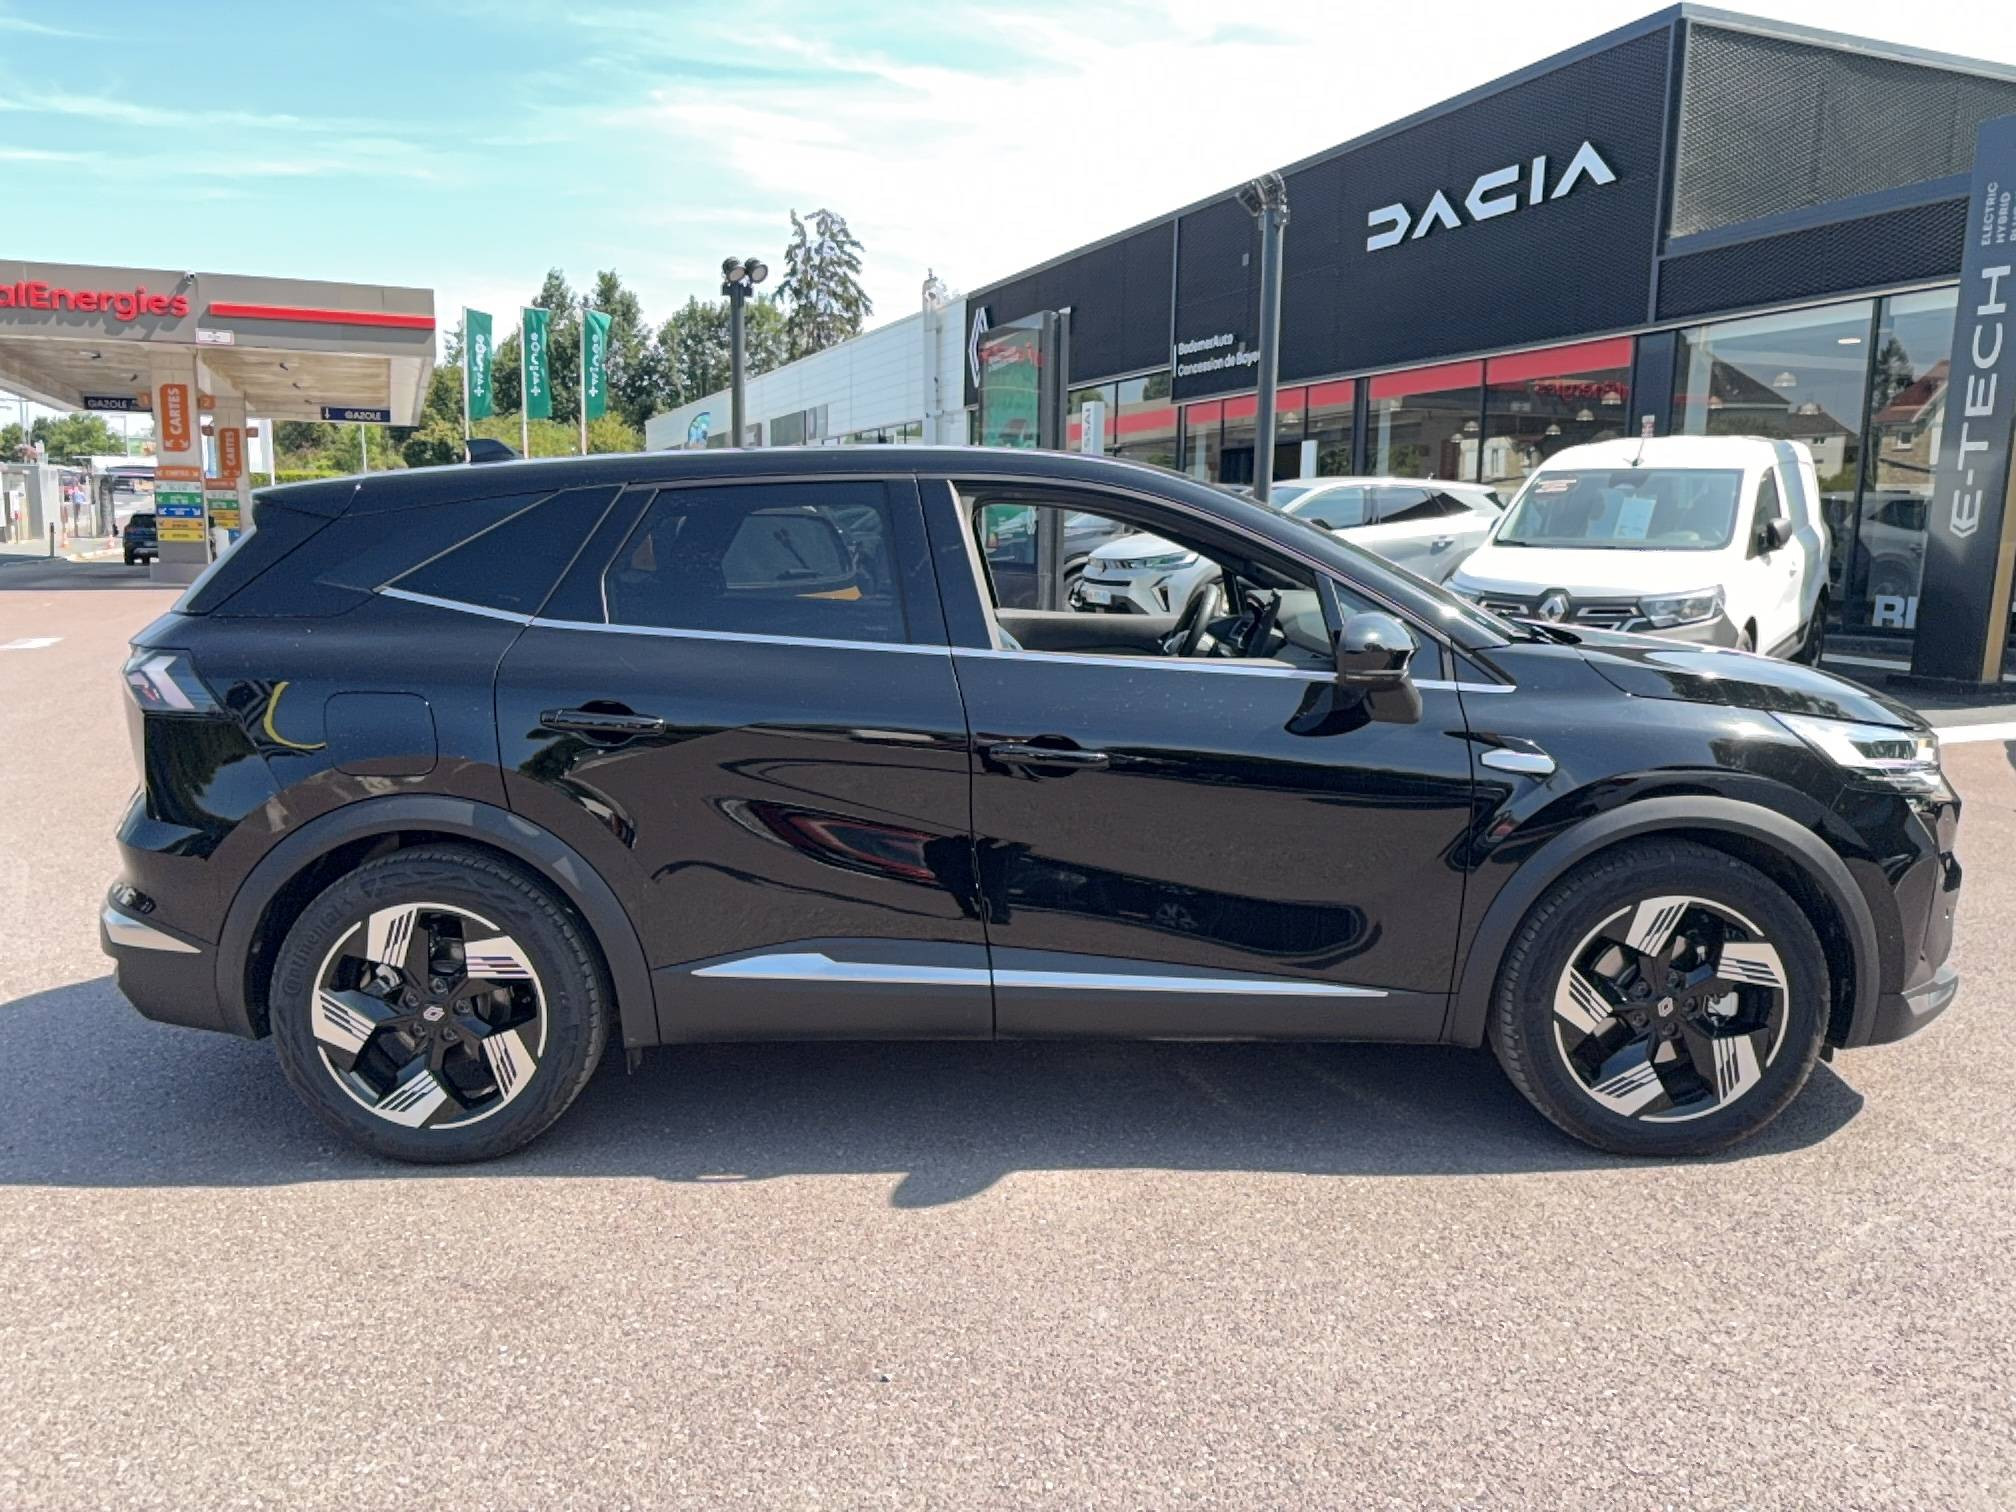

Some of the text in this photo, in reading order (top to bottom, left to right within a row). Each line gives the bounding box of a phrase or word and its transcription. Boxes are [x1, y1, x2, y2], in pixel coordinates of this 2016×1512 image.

[1367, 141, 1616, 252] DACIA
[1981, 182, 1999, 246] ELECTRIC
[1996, 191, 2011, 243] HYBRID
[1225, 353, 1236, 368] de
[1236, 350, 1261, 367] Baye
[87, 399, 128, 409] GAZOLE
[167, 387, 184, 435] CARTES
[1949, 264, 2012, 538] E-TECH
